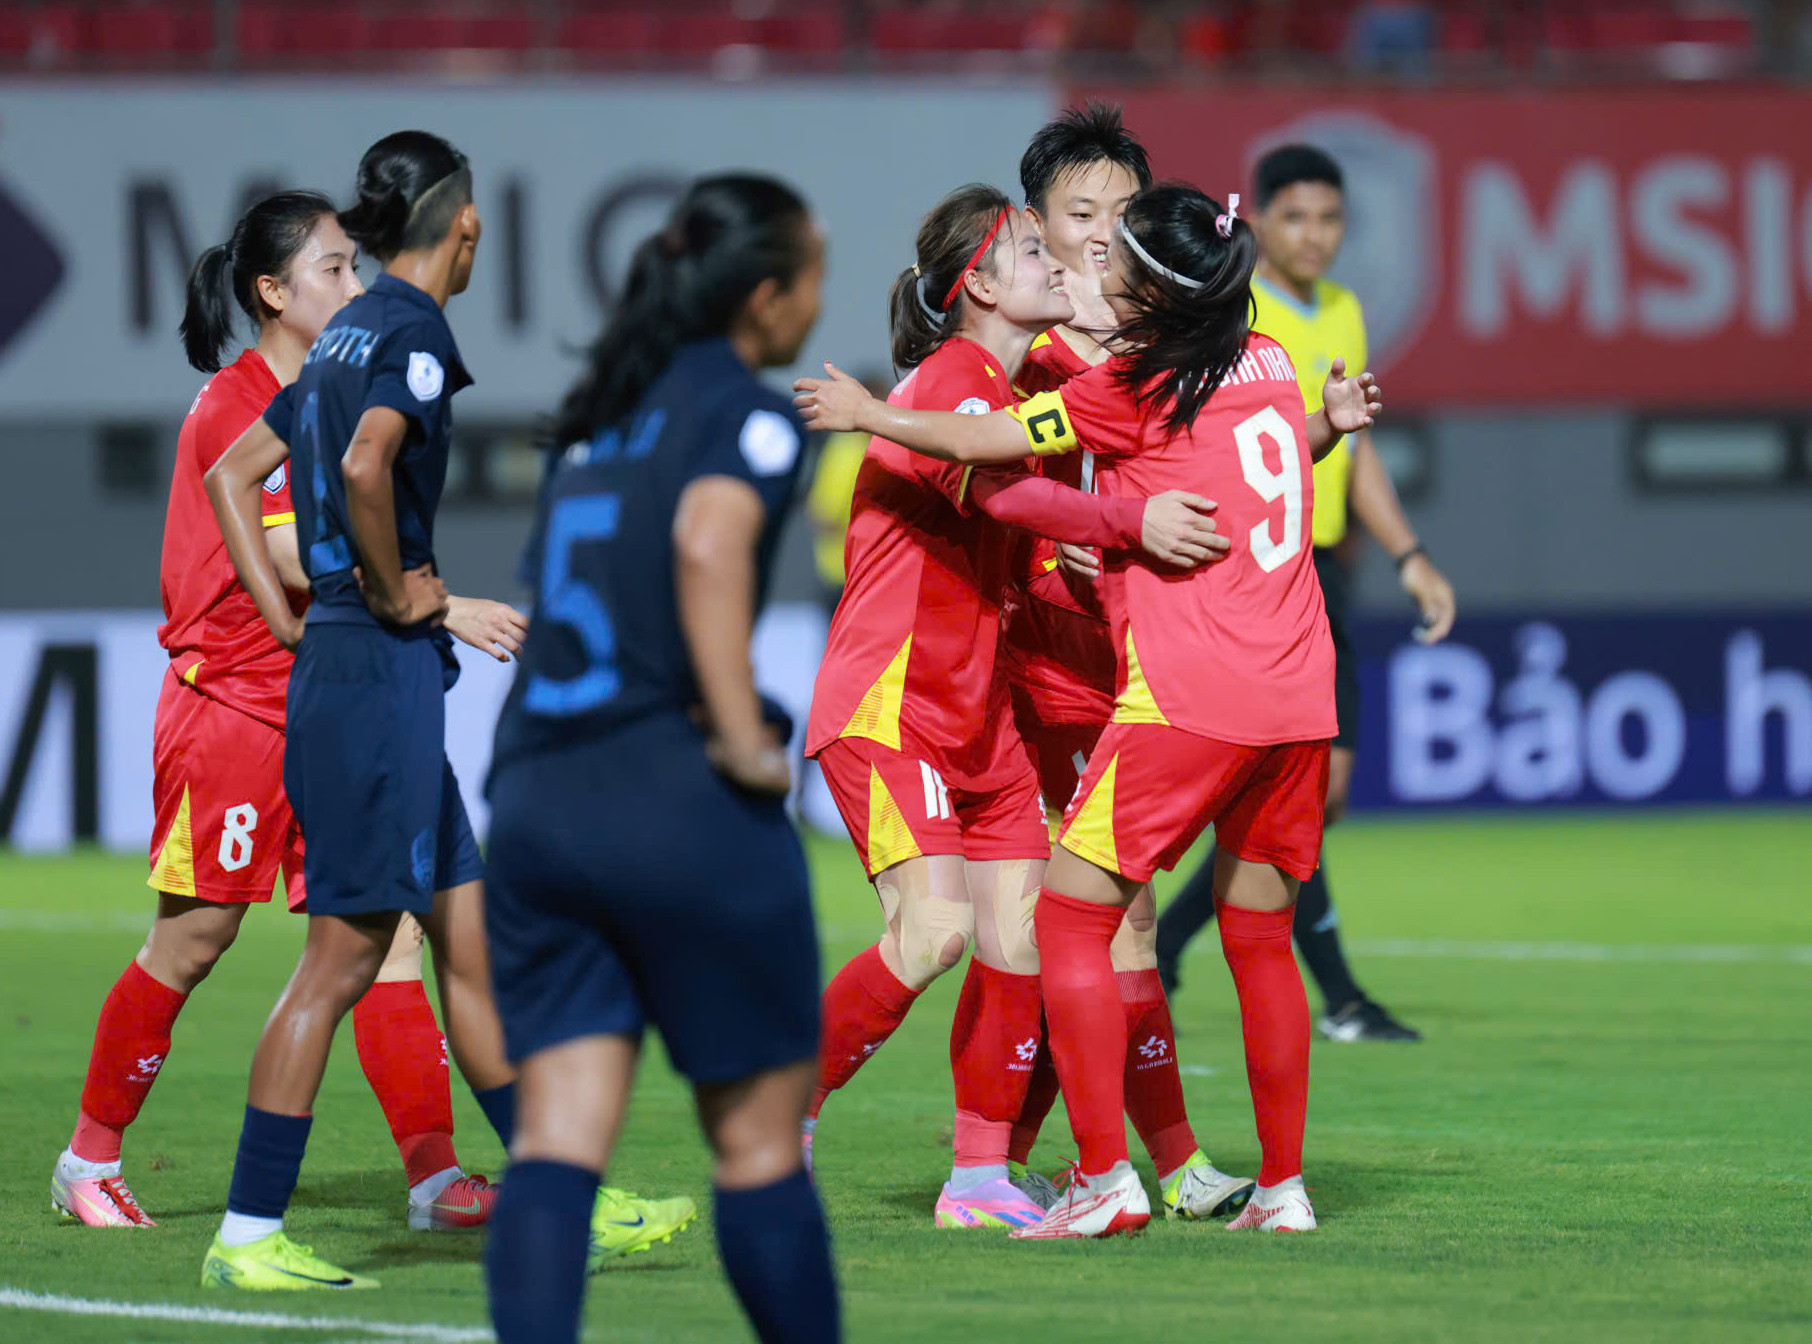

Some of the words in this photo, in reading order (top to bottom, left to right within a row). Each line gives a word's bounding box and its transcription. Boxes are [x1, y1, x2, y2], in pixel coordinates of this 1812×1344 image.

[1460, 157, 1812, 336] MSI
[1026, 408, 1067, 444] C
[1233, 405, 1303, 573] 9
[524, 493, 622, 716] 5
[1389, 621, 1686, 800] Bảo
[217, 802, 259, 872] 8
